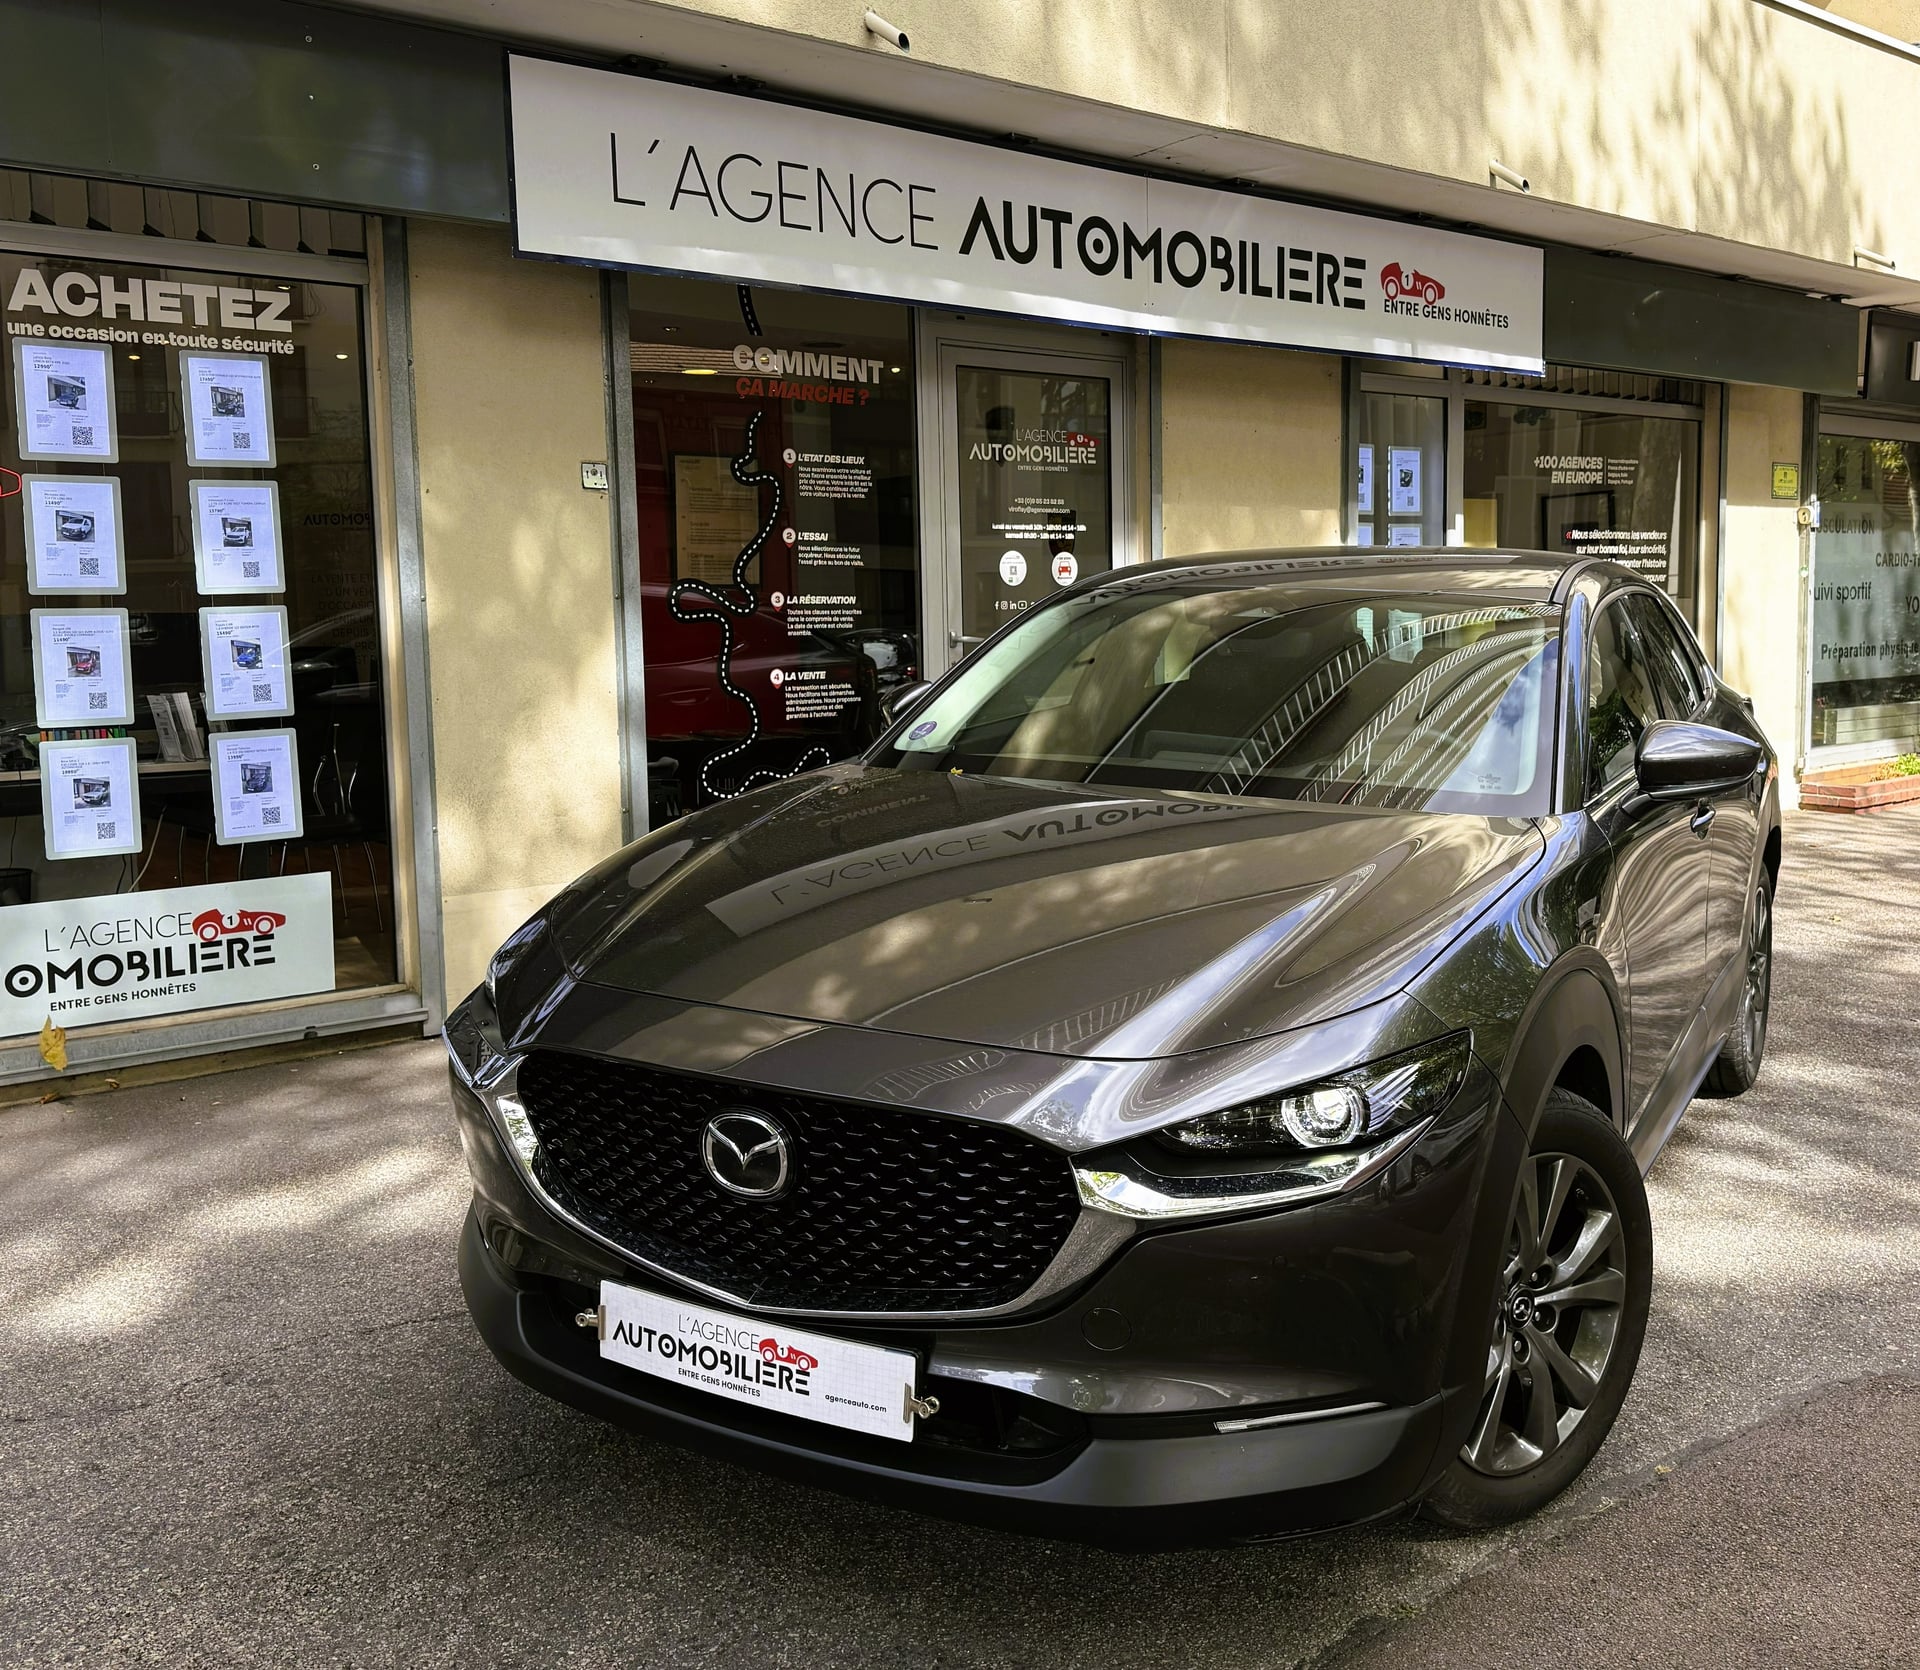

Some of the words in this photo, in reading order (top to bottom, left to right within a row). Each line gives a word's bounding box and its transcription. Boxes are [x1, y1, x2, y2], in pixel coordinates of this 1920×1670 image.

[610, 132, 939, 251] L'AGENCE
[7, 268, 292, 332] ACHETEZ
[1384, 298, 1419, 318] ENTRE
[1422, 302, 1452, 322] GENS
[1454, 304, 1509, 329] HONNÊTES
[7, 321, 45, 337] une
[48, 324, 138, 344] occasion
[142, 332, 165, 345] en
[169, 331, 218, 350] toute
[222, 335, 295, 355] sécurité
[732, 344, 884, 384] COMMENT
[735, 377, 764, 399] ÇA
[767, 379, 855, 404] MARCHE
[858, 389, 870, 405] ?
[1015, 428, 1067, 444] L'AGENCE
[798, 453, 824, 463] L'ETAT
[824, 454, 841, 463] DES
[841, 455, 865, 465] LIEUX
[1534, 456, 1558, 469] +100
[1559, 456, 1603, 470] AGENCES
[1551, 471, 1565, 484] EN
[1566, 471, 1603, 484] EUROPE
[798, 532, 829, 541] L'ESSAI
[1572, 529, 1589, 540] Nous
[1640, 530, 1667, 540] vendeurs
[1576, 545, 1587, 554] sur
[786, 596, 798, 605] LA
[799, 594, 856, 605] RÉSERVATION
[1814, 582, 1833, 601] uivi
[1836, 582, 1872, 604] sportif
[1821, 640, 1877, 663] Préparation
[1880, 638, 1919, 660] physique
[785, 672, 796, 681] LA
[798, 671, 826, 680] VENTE
[45, 912, 193, 952] L'AGENCE
[50, 996, 90, 1012] ENTRE
[94, 991, 128, 1006] GENS
[132, 982, 197, 1001] HONNÊTES
[678, 1314, 760, 1351] L'AGENCE
[678, 1368, 700, 1381] ENTRE
[701, 1373, 720, 1387] GENS
[721, 1379, 761, 1397] HONNÊTES
[825, 1393, 887, 1414] agenceauto.com
